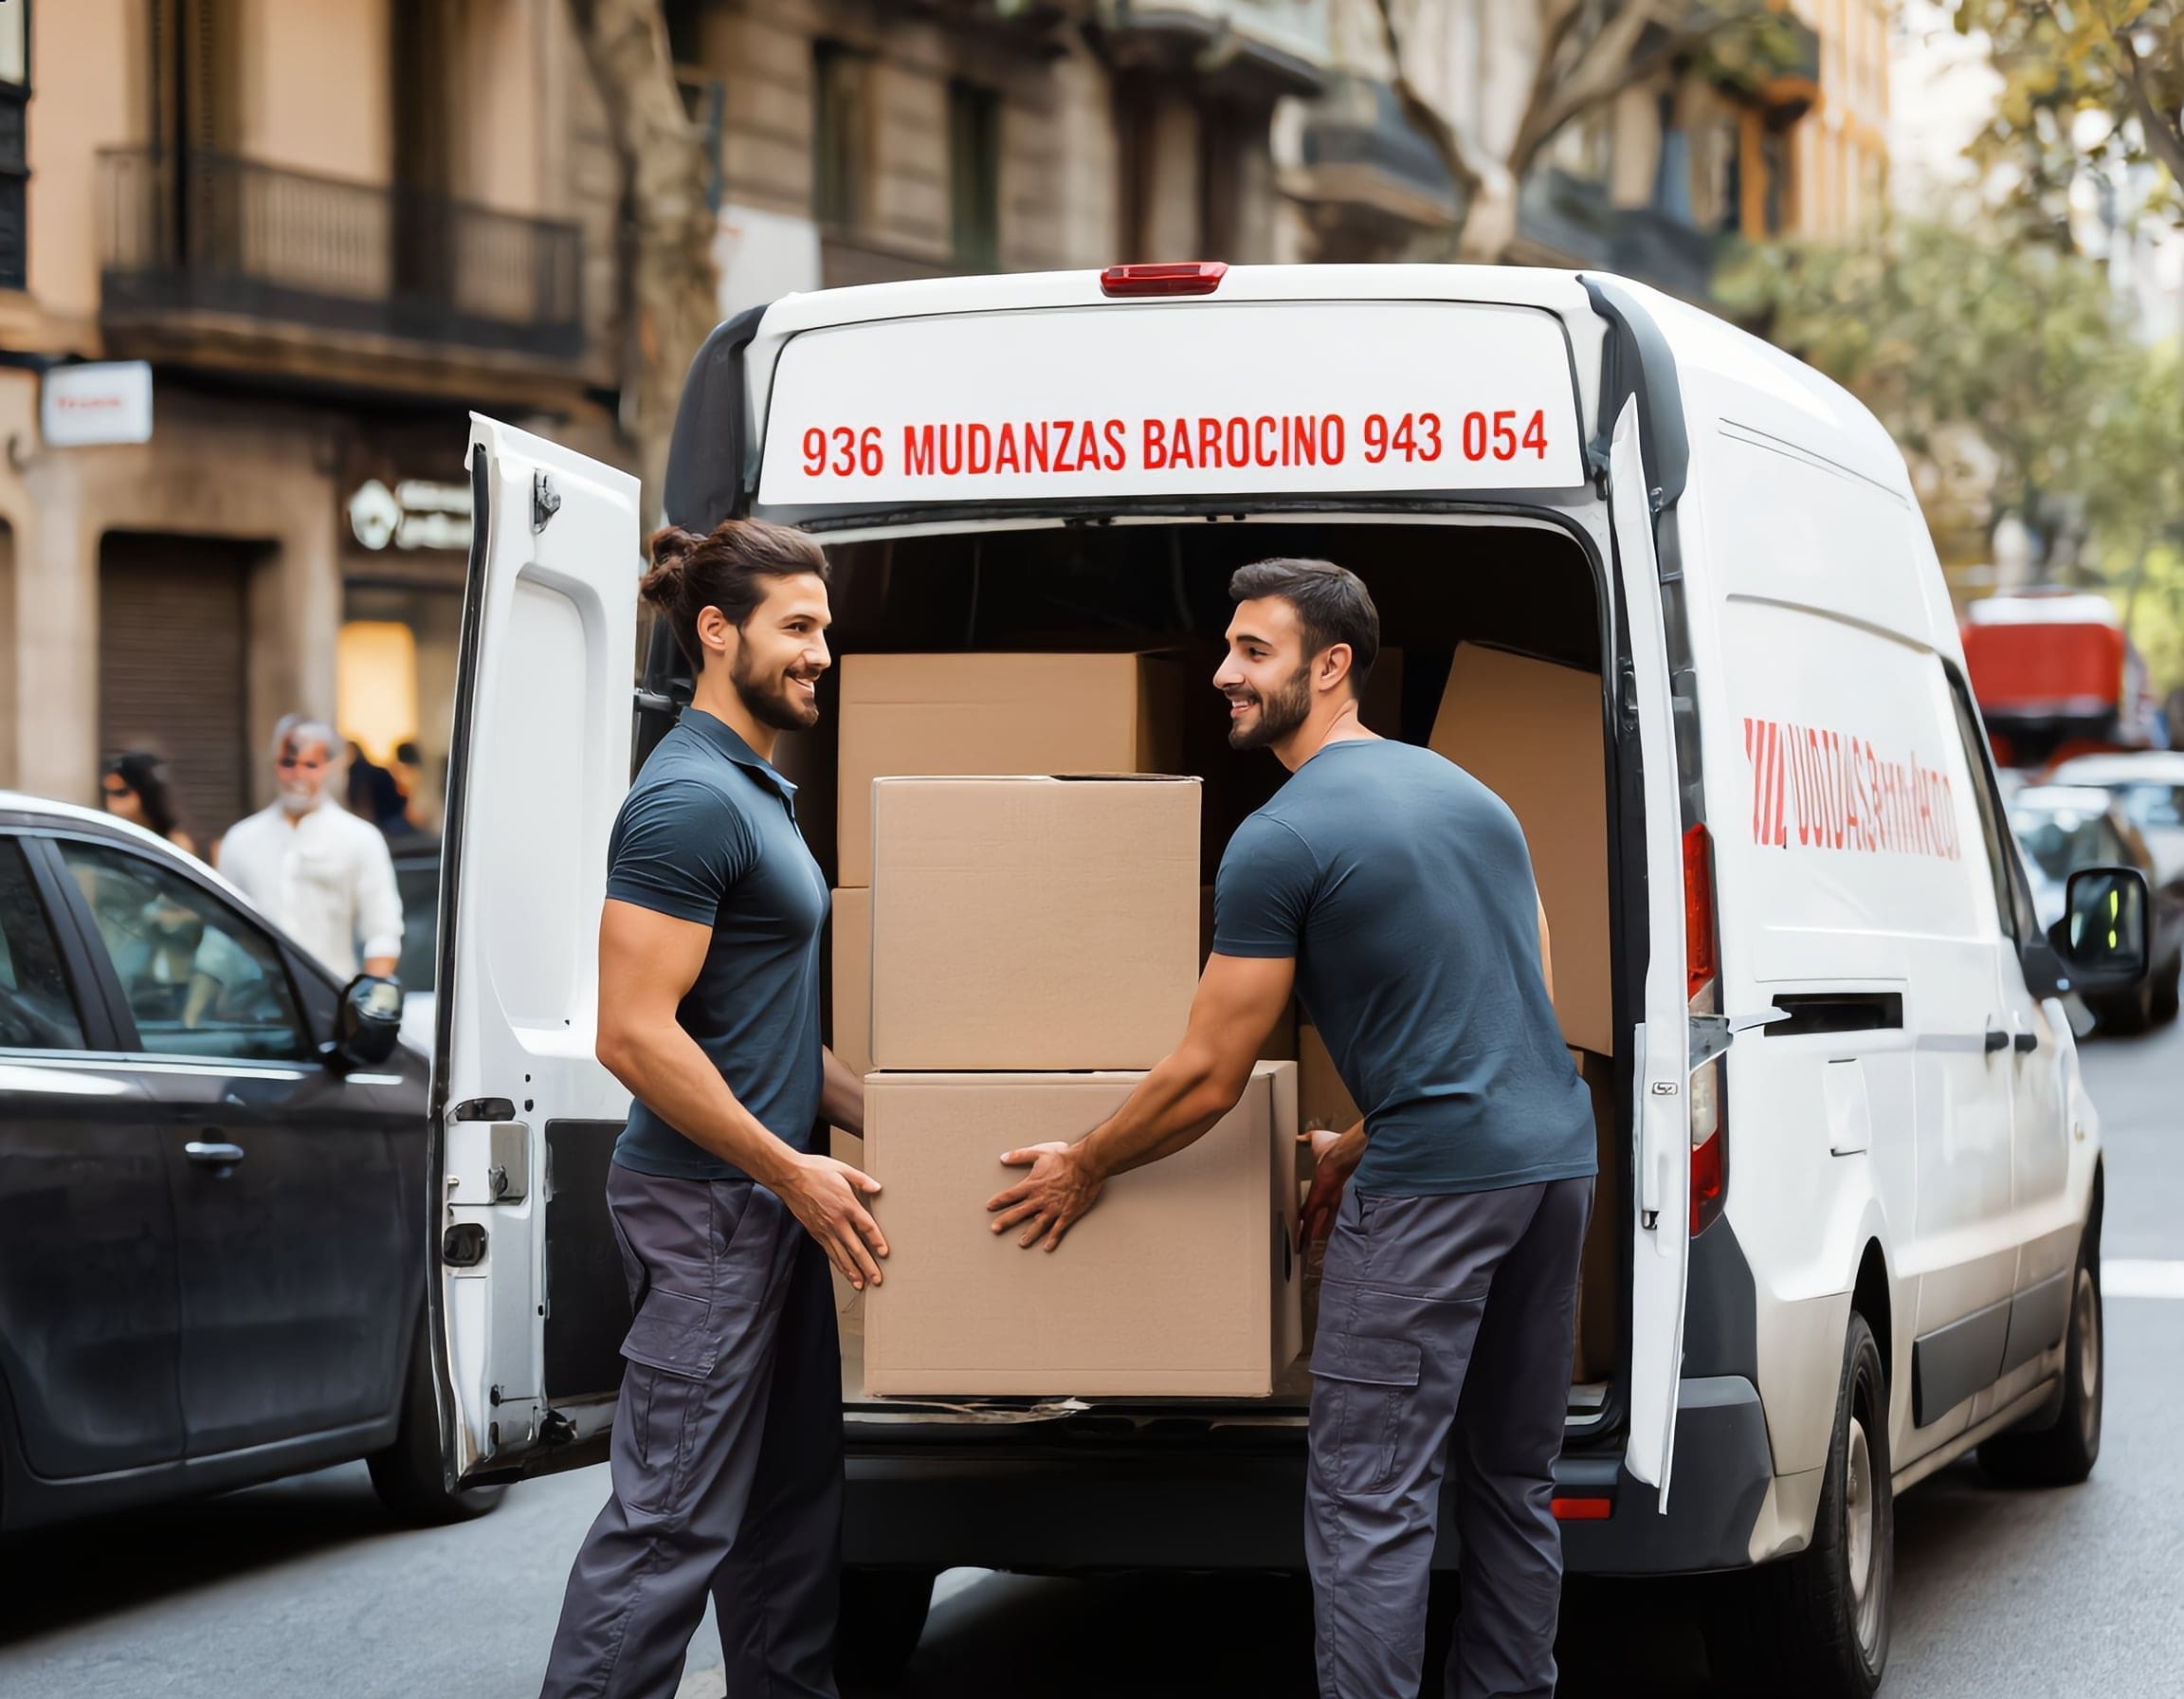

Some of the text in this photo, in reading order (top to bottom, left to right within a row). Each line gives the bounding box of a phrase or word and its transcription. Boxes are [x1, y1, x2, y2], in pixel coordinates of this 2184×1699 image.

[802, 409, 1549, 478] 936 MUDANZAS BAROCINO 943 054
